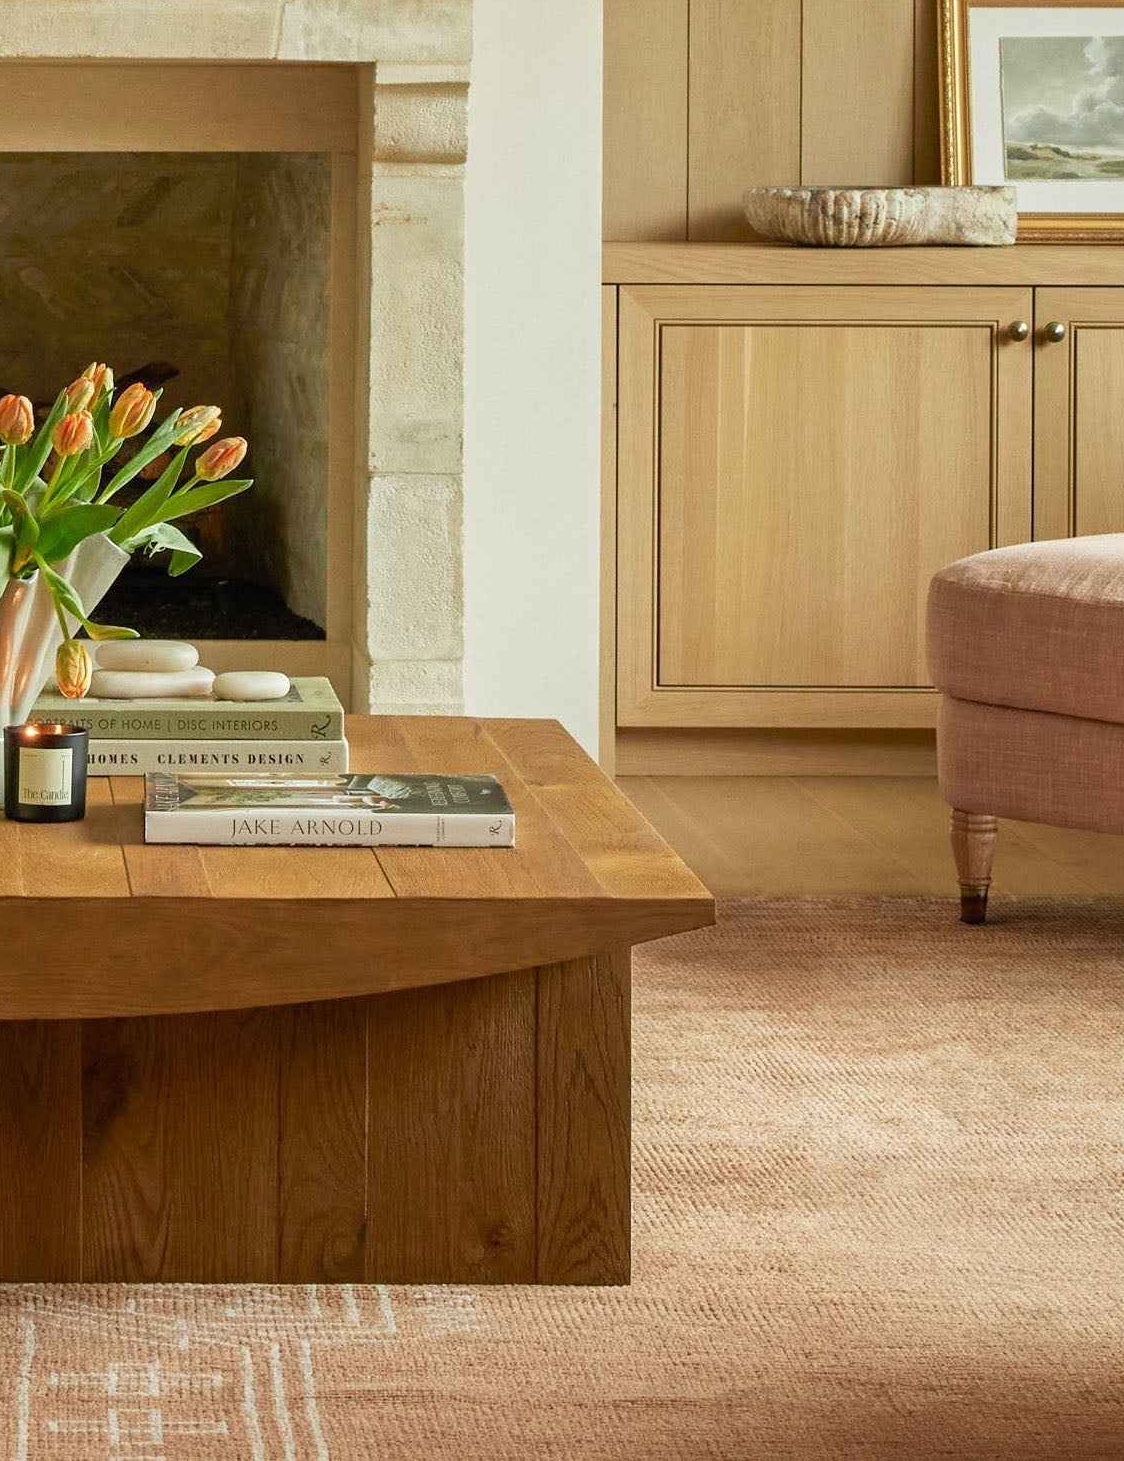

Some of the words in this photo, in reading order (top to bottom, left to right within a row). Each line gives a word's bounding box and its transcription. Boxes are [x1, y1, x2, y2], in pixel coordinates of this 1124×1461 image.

[98, 718, 117, 730] OF
[121, 718, 161, 730] HOME
[178, 719, 207, 731] DISC
[212, 720, 278, 731] INTERIORS
[87, 753, 138, 764] HOMES
[157, 753, 240, 764] CLEMENTS
[247, 753, 304, 764] DESIGN
[229, 818, 281, 837] JAKE
[290, 819, 383, 836] ARNOLD
